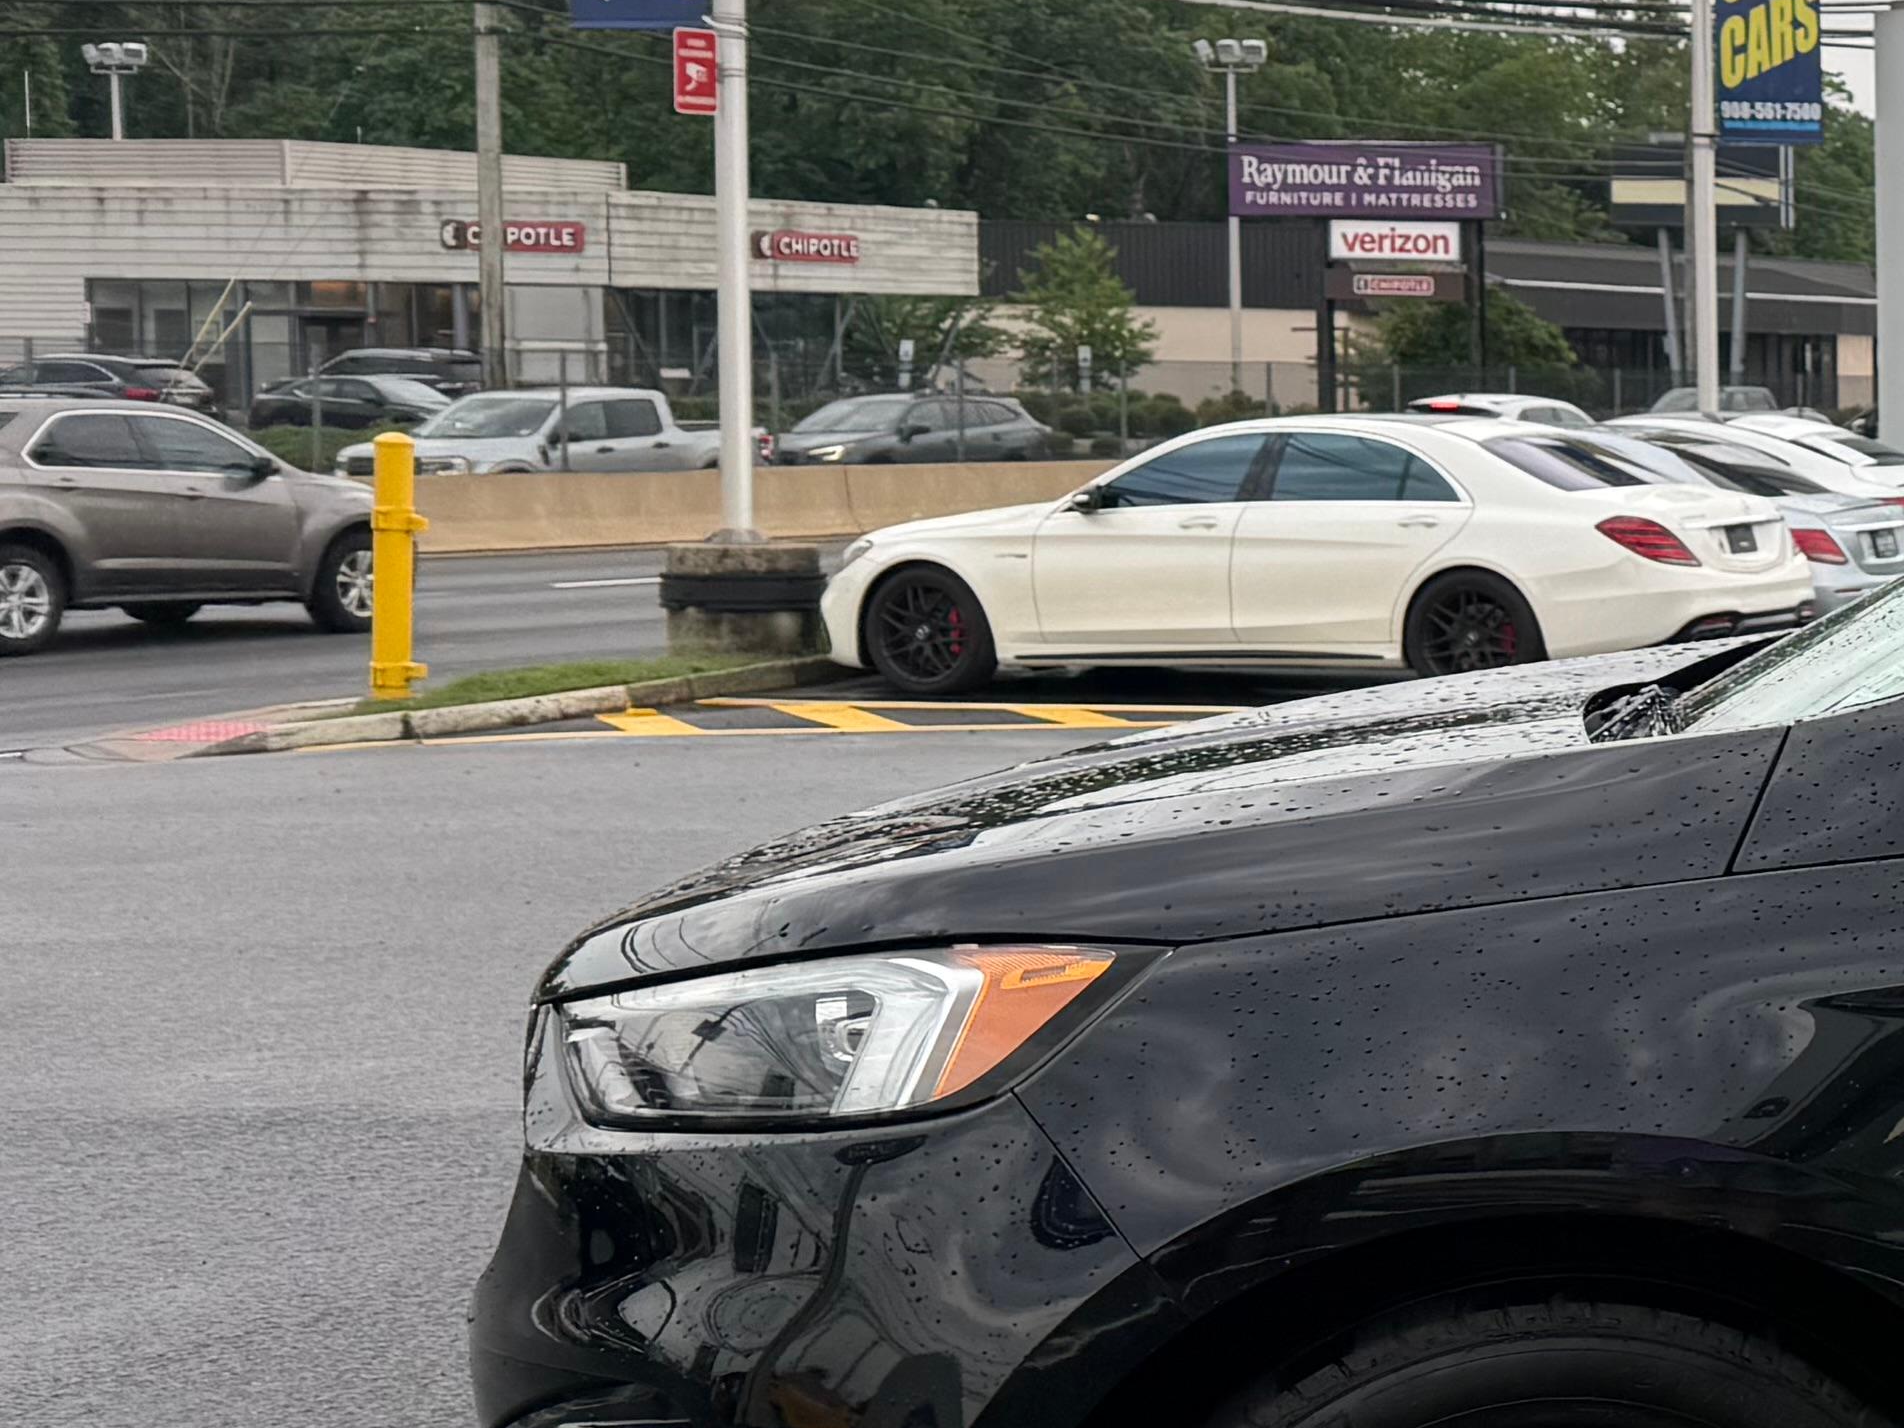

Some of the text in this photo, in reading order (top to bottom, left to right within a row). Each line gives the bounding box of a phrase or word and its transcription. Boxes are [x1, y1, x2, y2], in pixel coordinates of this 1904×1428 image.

[1240, 155, 1481, 192] Raymour & Flanigan
[1245, 191, 1478, 208] FURNITURE MATTRESSES
[466, 226, 576, 246] CPOTLE
[779, 236, 859, 258] CHIPOTLE
[1341, 227, 1450, 255] verizon
